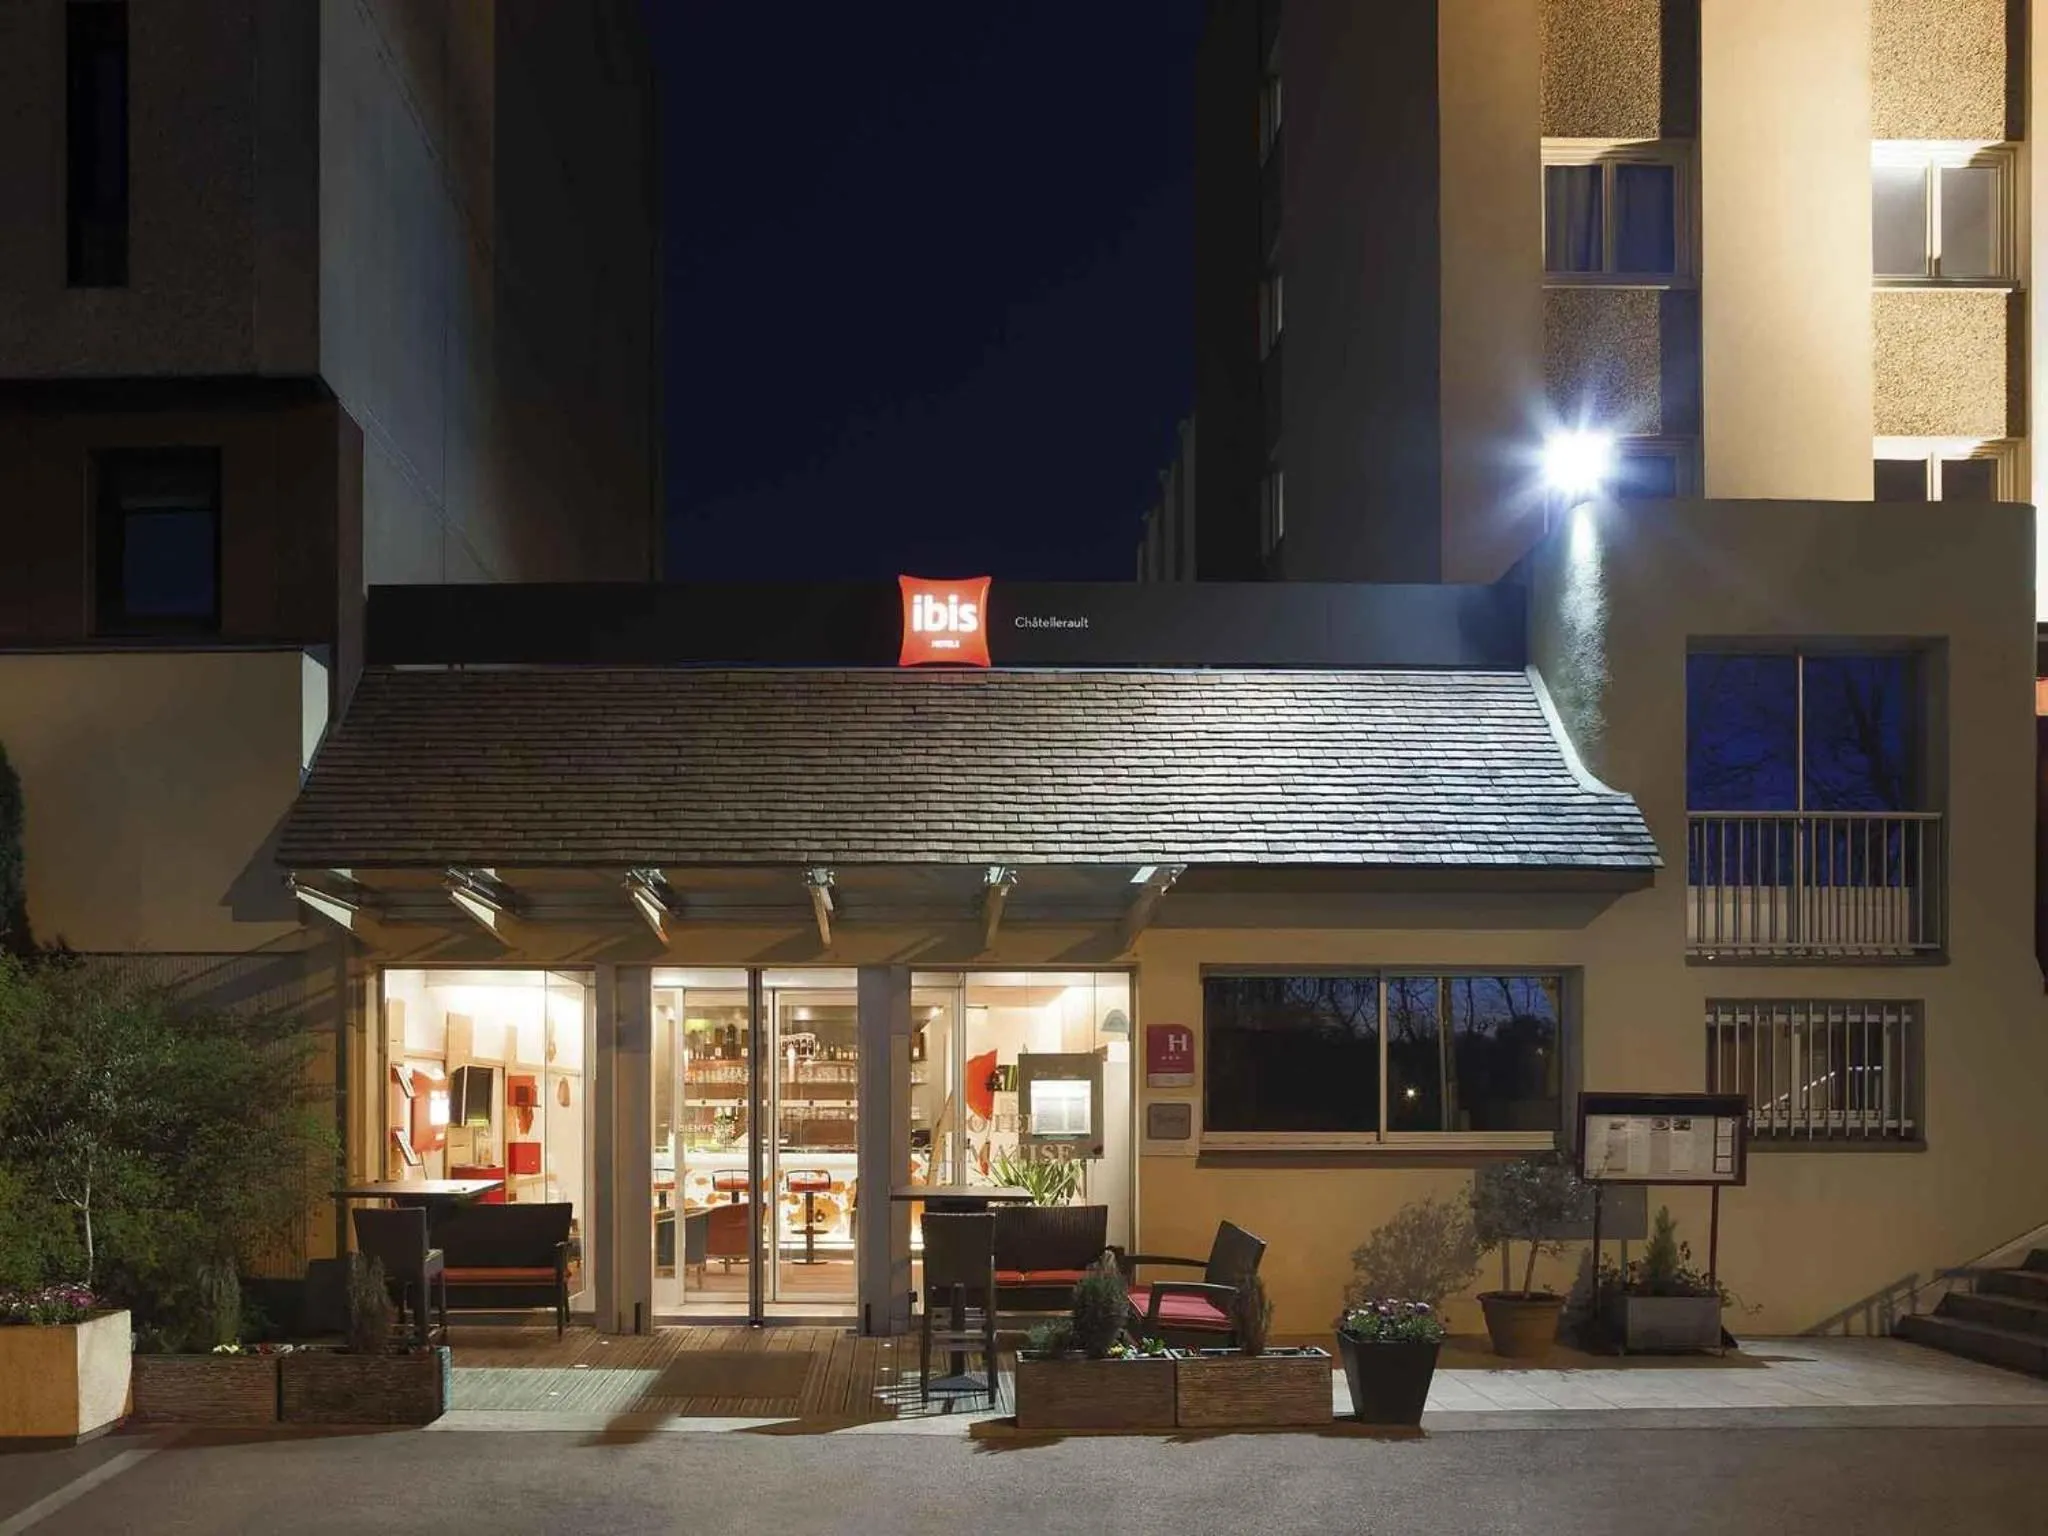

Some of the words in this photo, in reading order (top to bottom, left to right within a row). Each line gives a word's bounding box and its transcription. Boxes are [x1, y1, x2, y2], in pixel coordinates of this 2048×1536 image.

[912, 593, 979, 633] ibis
[1014, 615, 1089, 629] Châtellerault
[1168, 1033, 1188, 1052] H
